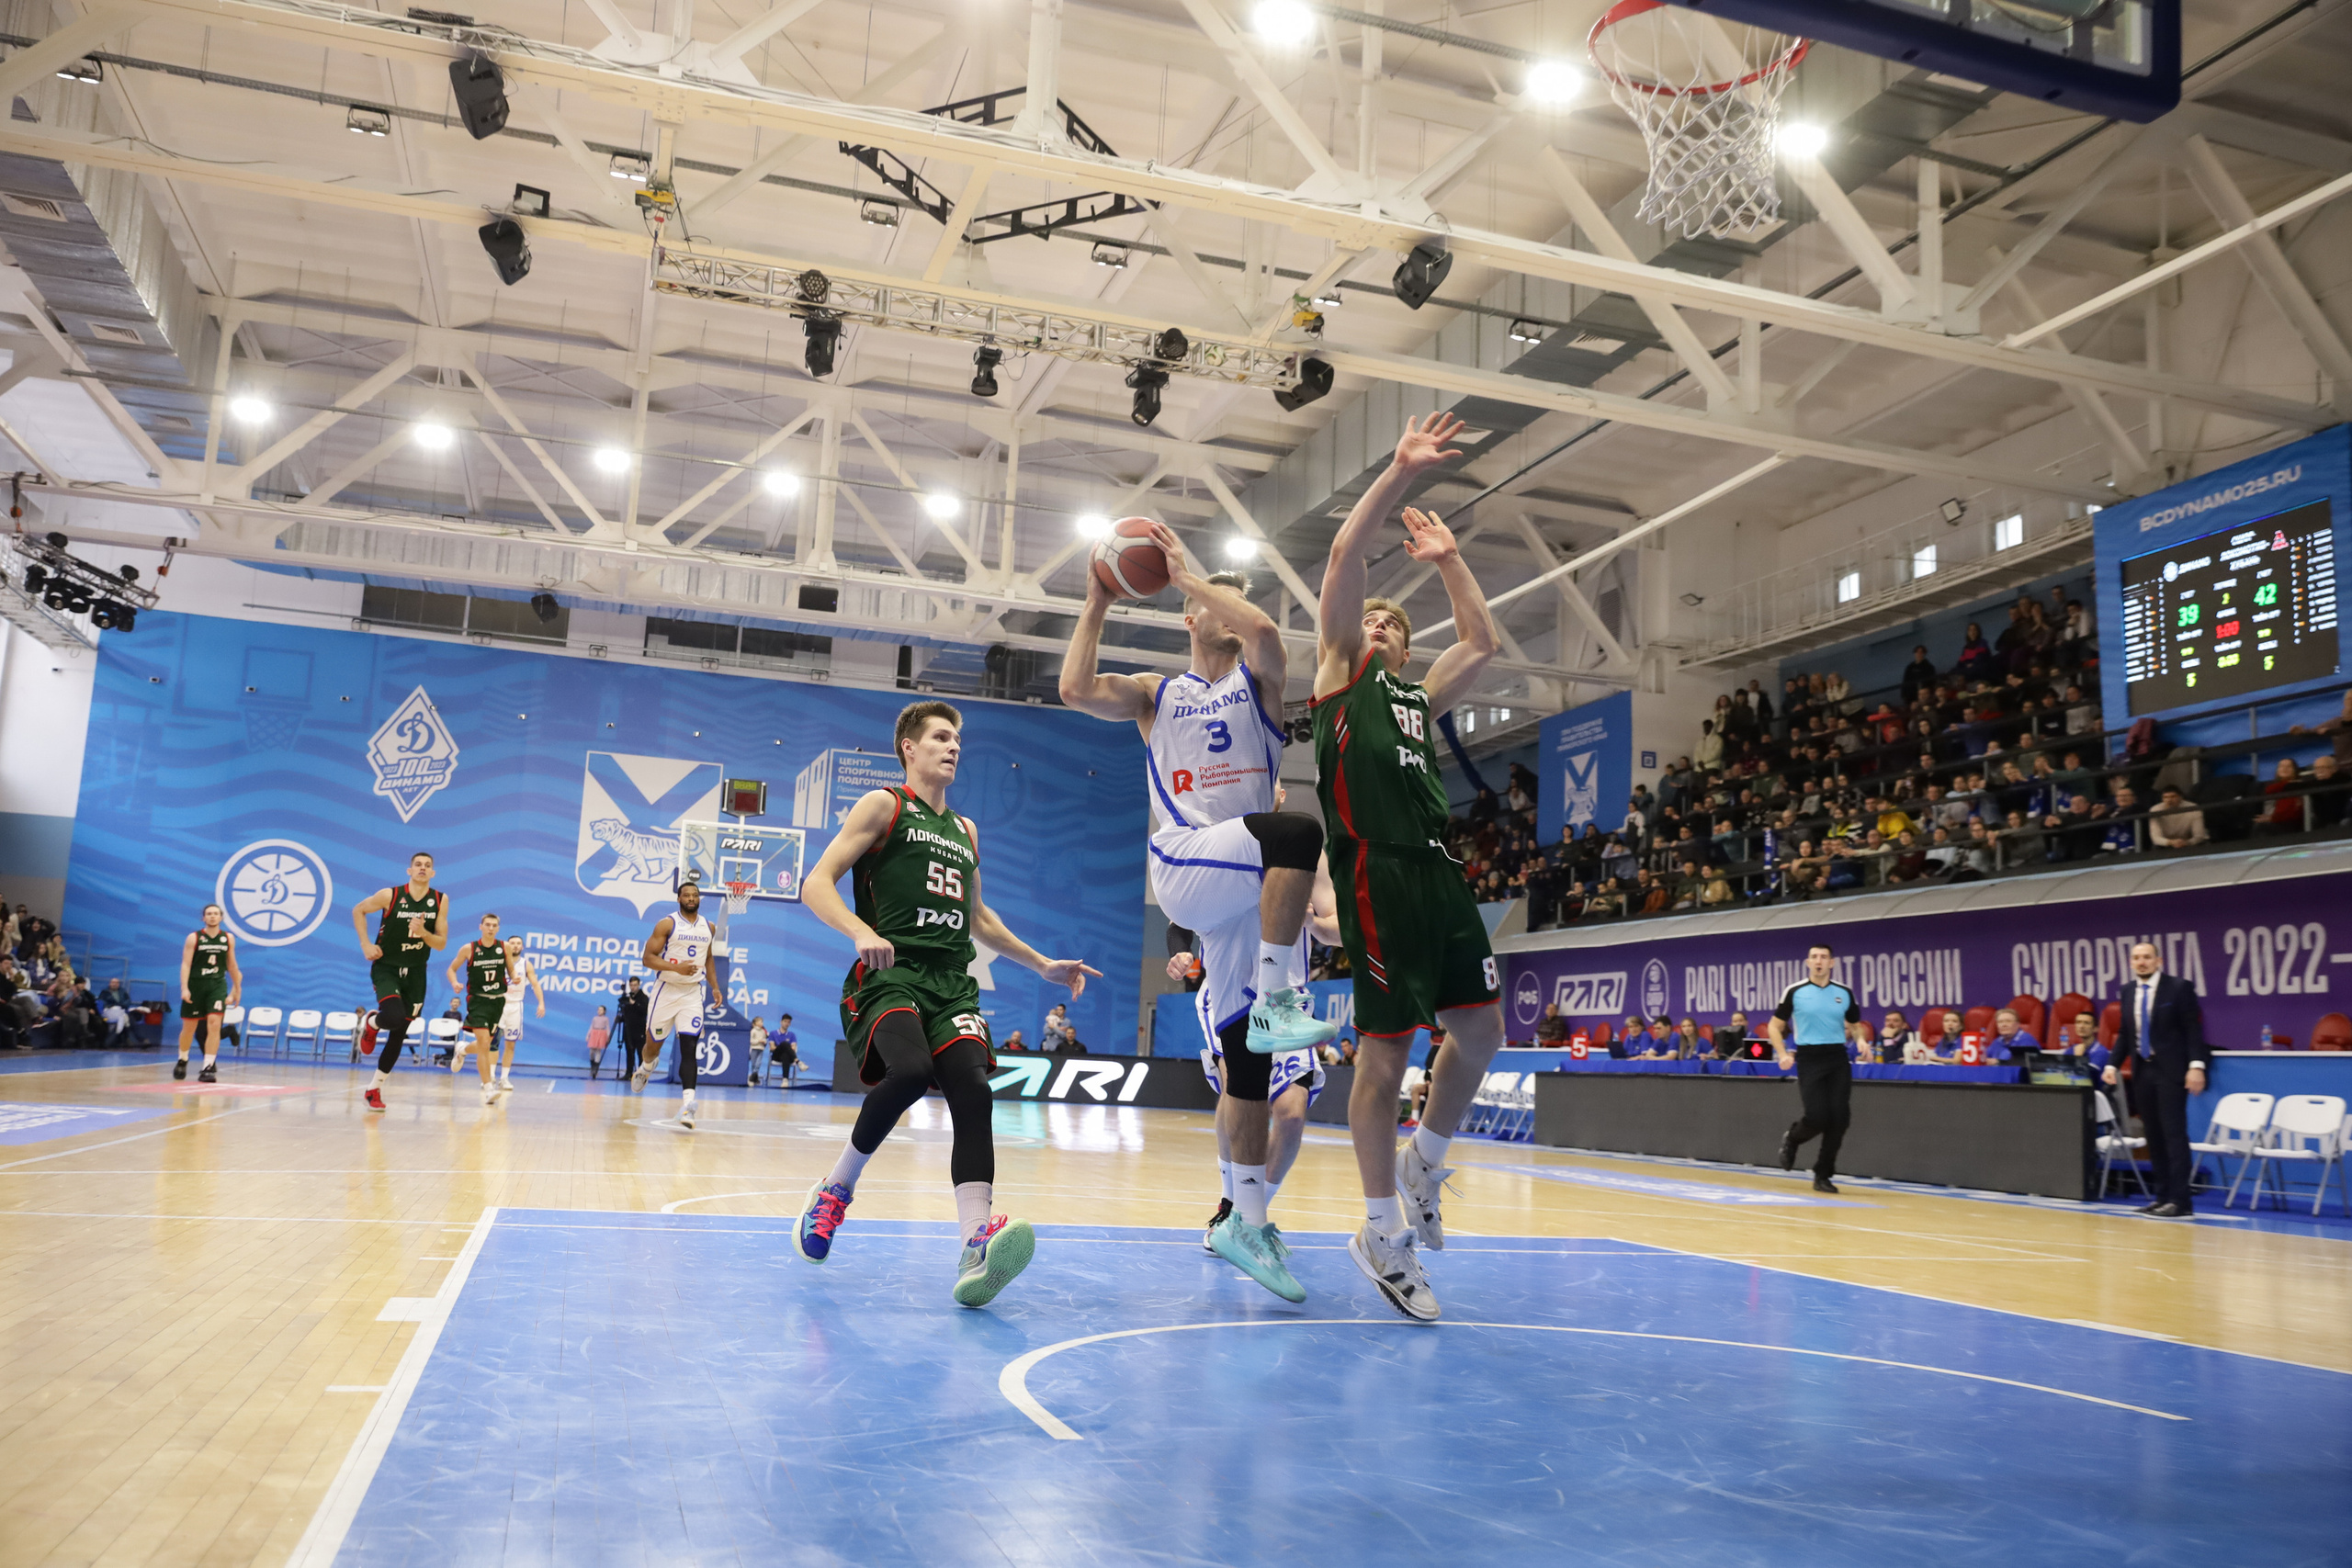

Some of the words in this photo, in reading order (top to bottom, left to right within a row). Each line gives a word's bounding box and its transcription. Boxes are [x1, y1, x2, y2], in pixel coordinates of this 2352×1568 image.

[2139, 465, 2302, 533] BCDYNAMO25.RU
[2254, 583, 2278, 606] 42
[2177, 604, 2200, 626] 39
[1172, 689, 1250, 719] ДИНАМО
[1391, 704, 1424, 742] 88
[1205, 720, 1232, 753] 3
[393, 757, 433, 777] 100
[839, 757, 872, 767] ЦЕНТР
[1198, 762, 1230, 773] Русская
[380, 773, 445, 790] ДИНАМО
[837, 775, 903, 788] ПОДГОТОВКИ
[838, 766, 905, 780] СПОРТИВНОЙ
[1202, 778, 1241, 789] Компания
[720, 837, 763, 852] PARI
[930, 846, 963, 863] КУБАНЬ
[926, 861, 963, 901] 55
[526, 931, 579, 952] ПРИ
[677, 933, 709, 943] ДИНАМО
[208, 954, 217, 965] 4
[687, 945, 696, 957] 6
[484, 969, 497, 982] 17
[1685, 964, 1725, 1012] PARI
[1730, 955, 1855, 1011] ЧЕМПТ
[1860, 948, 1963, 1008] РОССИИ
[1559, 977, 1623, 1010] PARI
[213, 1000, 222, 1010] 4
[691, 1016, 702, 1028] 6
[507, 1029, 519, 1037] 24
[1572, 1037, 1587, 1057] 5
[1962, 1035, 1977, 1063] 5
[988, 1055, 1150, 1102] ARI
[1272, 1055, 1301, 1086] 26
